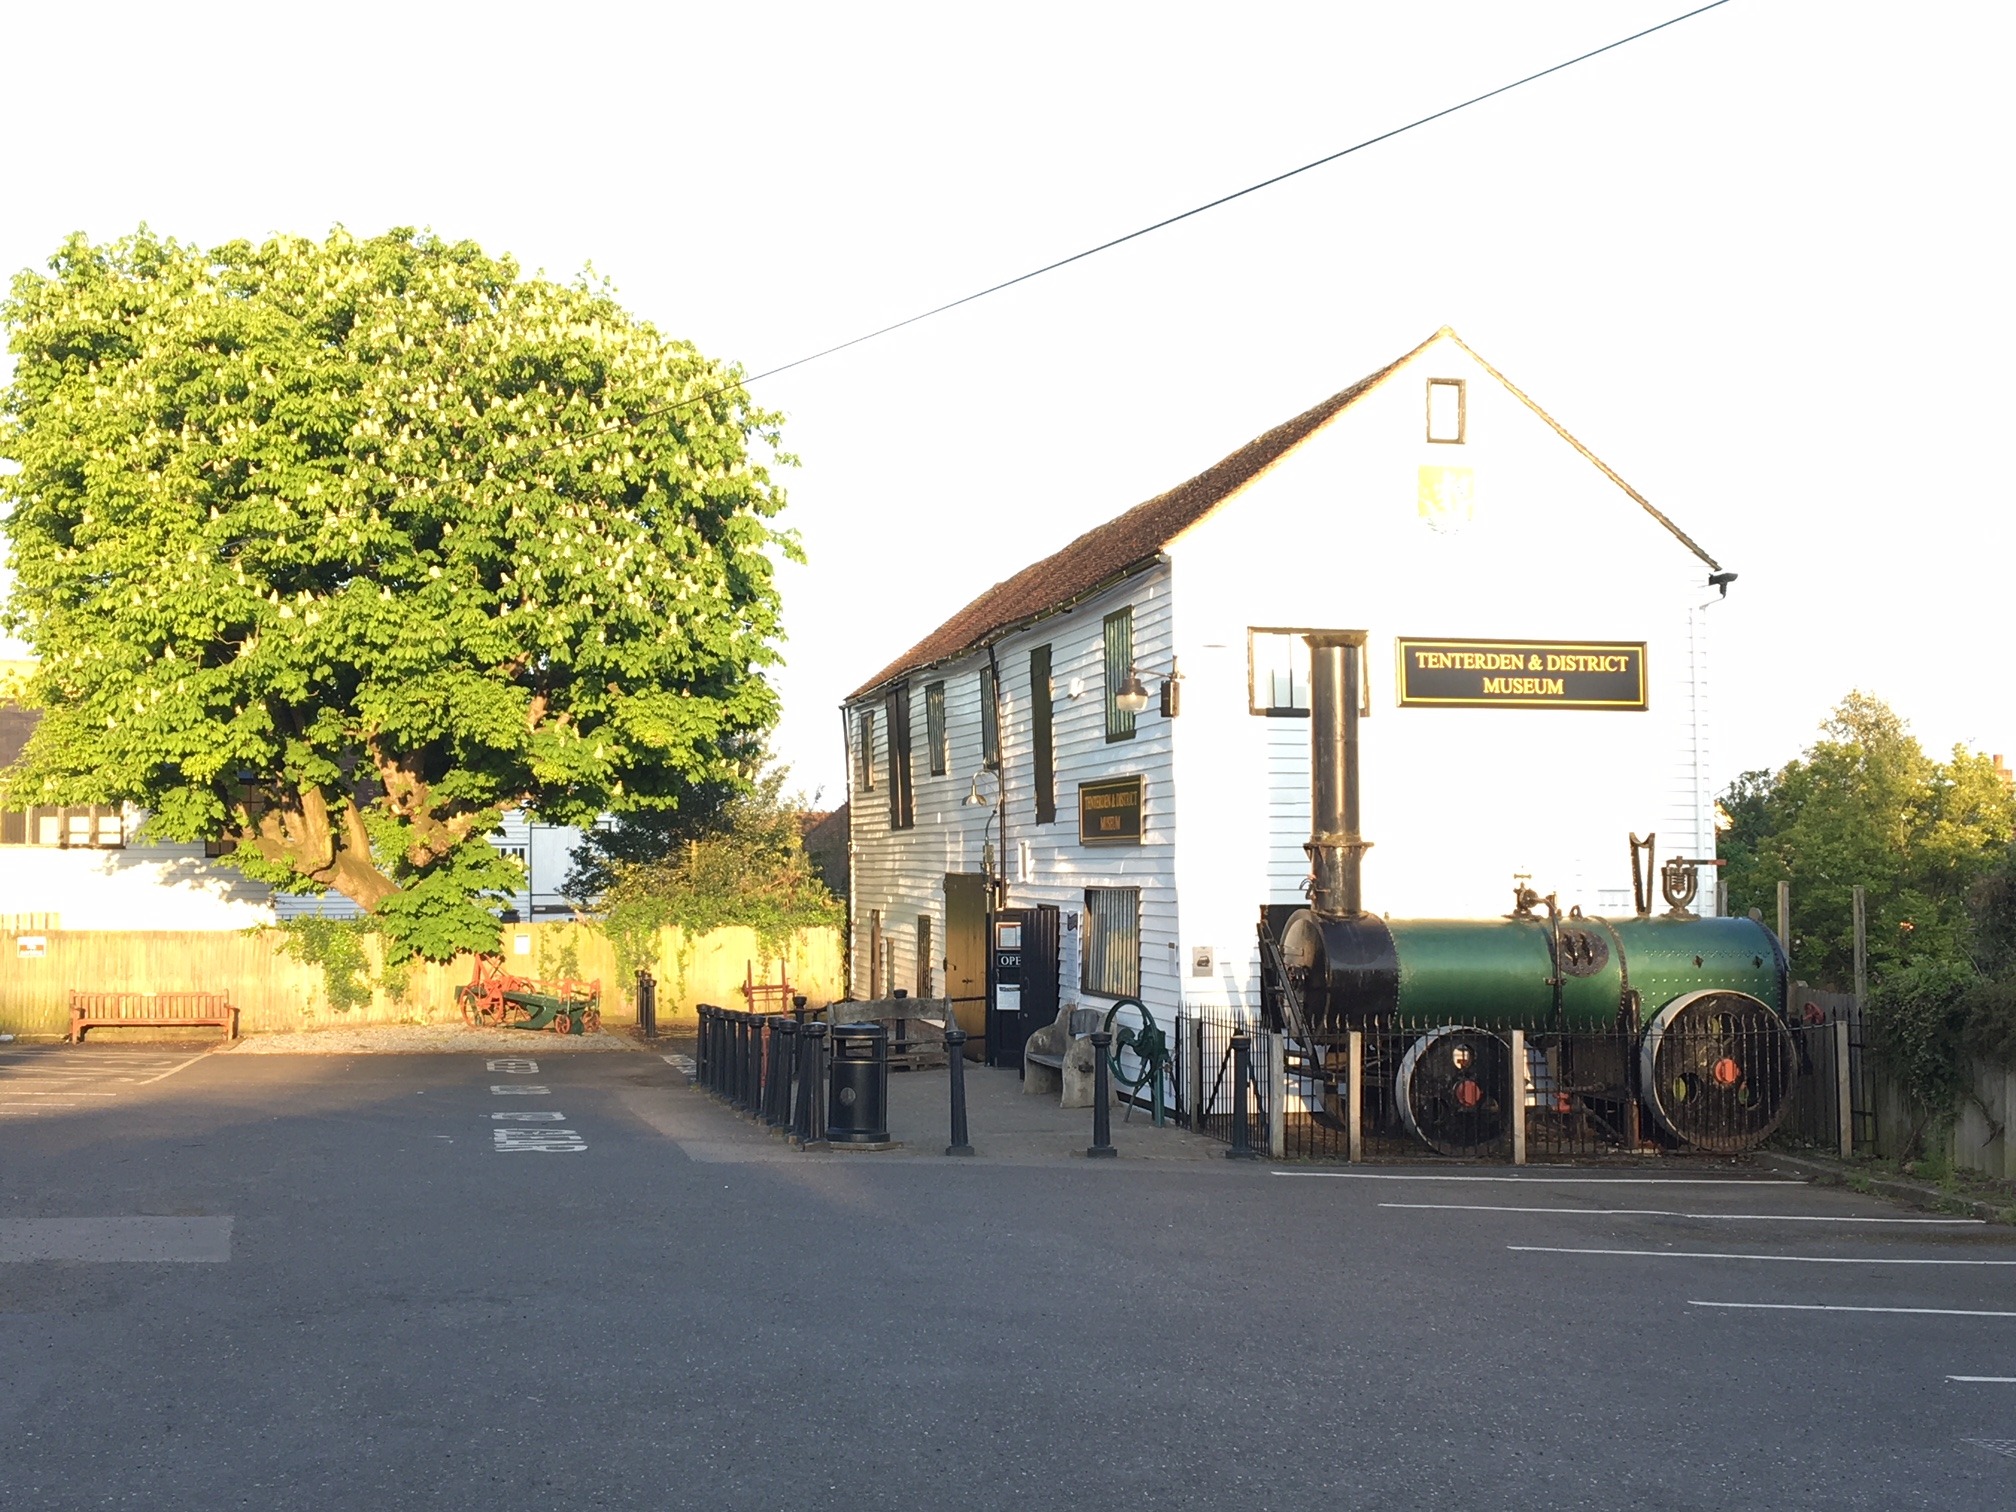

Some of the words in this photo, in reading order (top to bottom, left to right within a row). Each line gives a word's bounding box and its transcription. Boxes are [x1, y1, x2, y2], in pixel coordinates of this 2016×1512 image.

[1416, 652, 1524, 670] TENTERDEN
[1527, 655, 1544, 671] &
[1546, 655, 1629, 672] DISTRICT
[1482, 677, 1564, 695] MUSEUM
